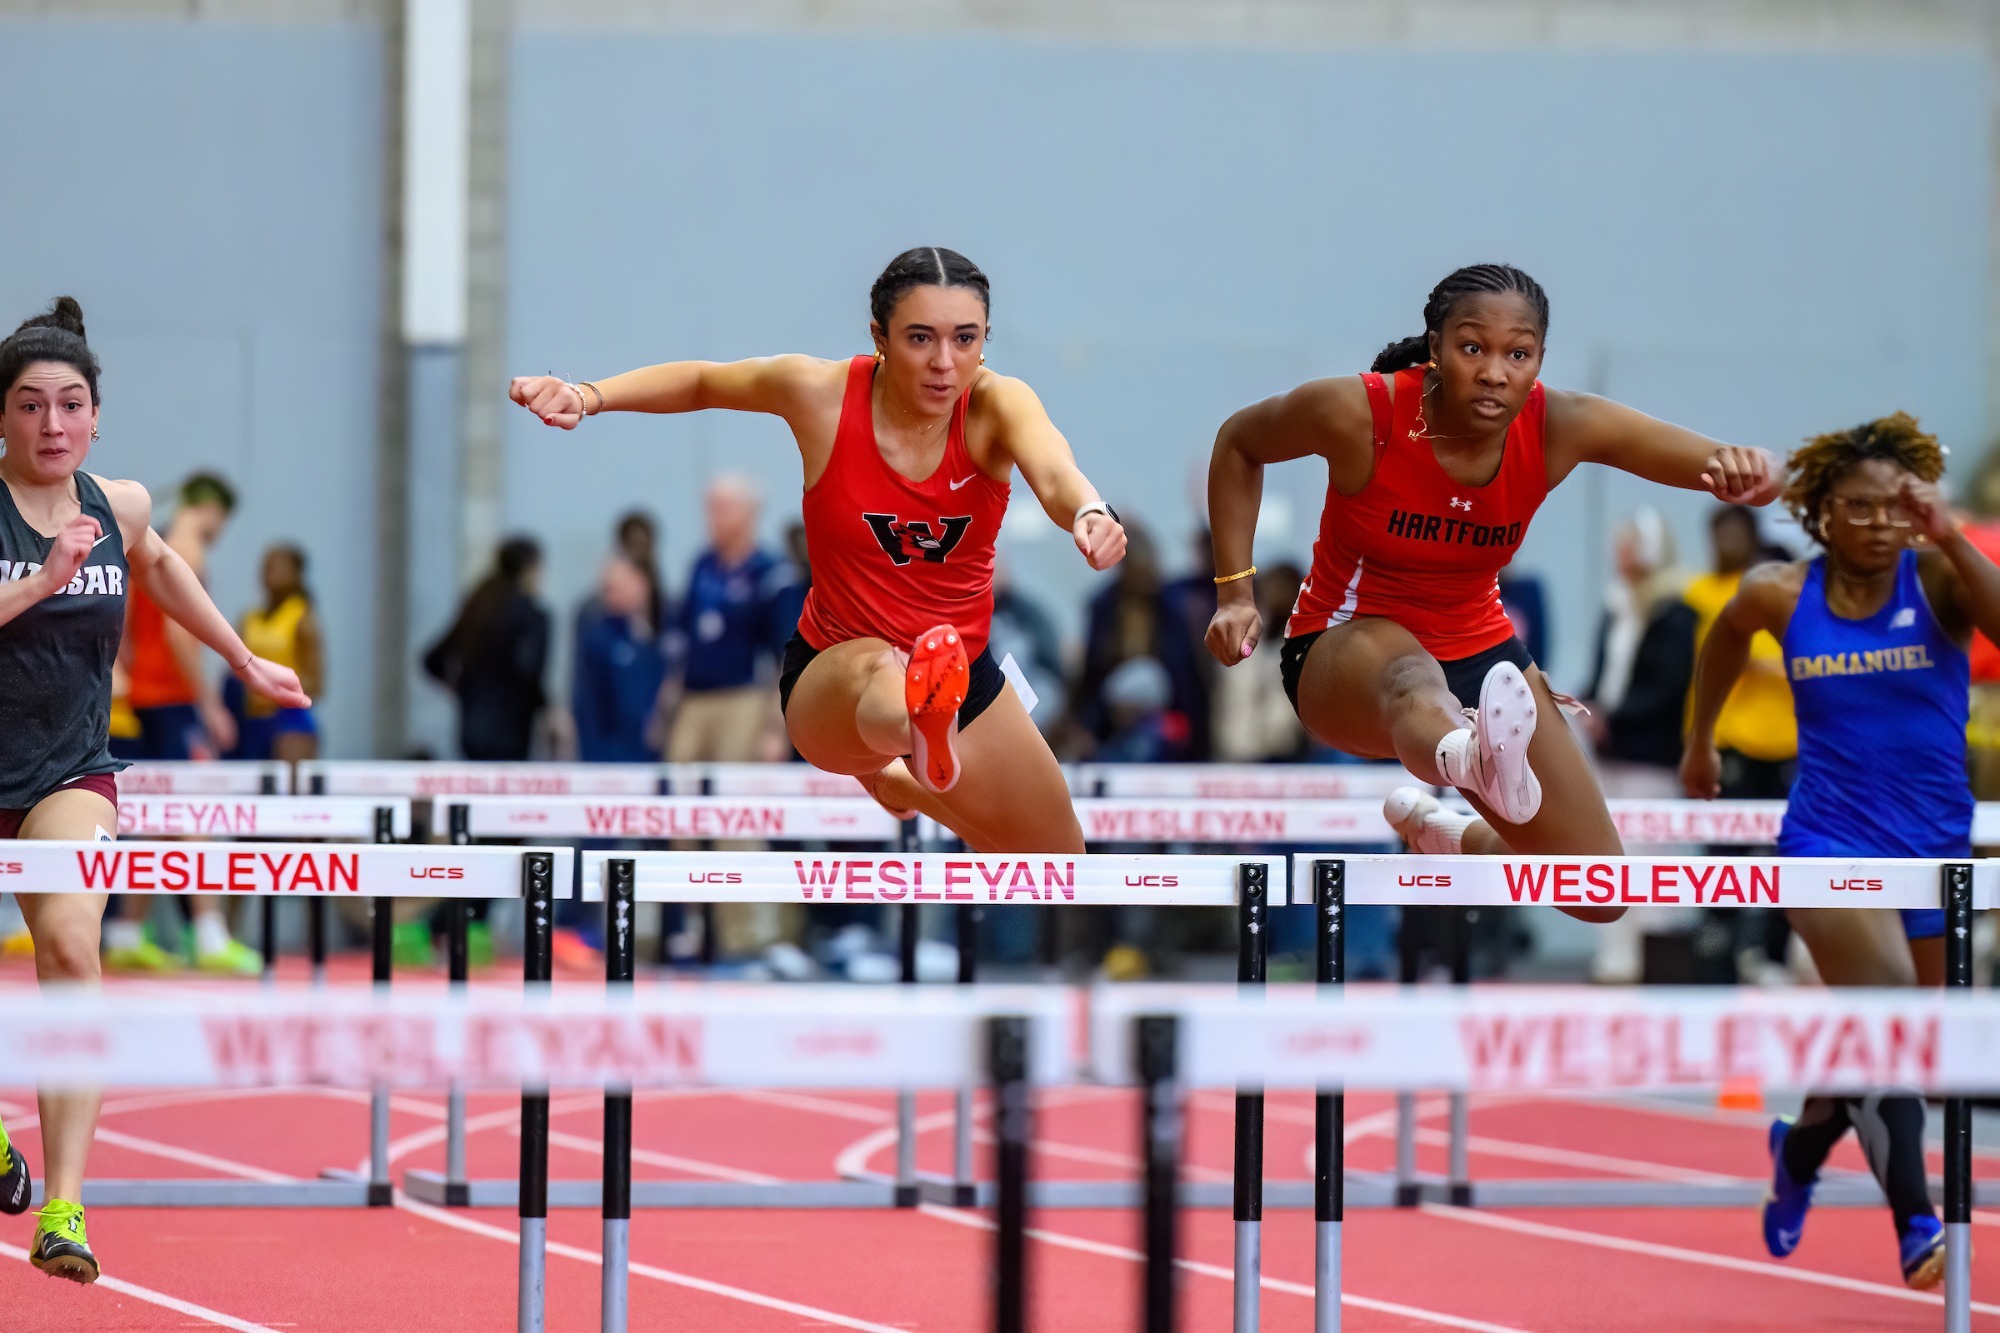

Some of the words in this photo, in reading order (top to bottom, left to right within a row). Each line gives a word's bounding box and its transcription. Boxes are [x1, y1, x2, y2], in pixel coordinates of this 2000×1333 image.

[1387, 509, 1521, 547] HARTFORD
[0, 560, 123, 596] VSAR
[1791, 645, 1935, 681] EMMANUEL
[585, 806, 785, 837] WESLEYAN
[1088, 809, 1286, 840] WESLEYAN
[76, 850, 359, 892] WESLEYAN
[410, 867, 464, 879] UCS
[688, 872, 742, 883] UCS
[794, 860, 1075, 900] WESLEYAN
[1125, 875, 1178, 887] UCS
[1398, 875, 1451, 887] UCS
[1503, 863, 1780, 903] WESLEYAN
[1830, 879, 1883, 890] UCS
[202, 1013, 703, 1084] WESLEYAN
[1461, 1014, 1938, 1090] WESLEYAN
